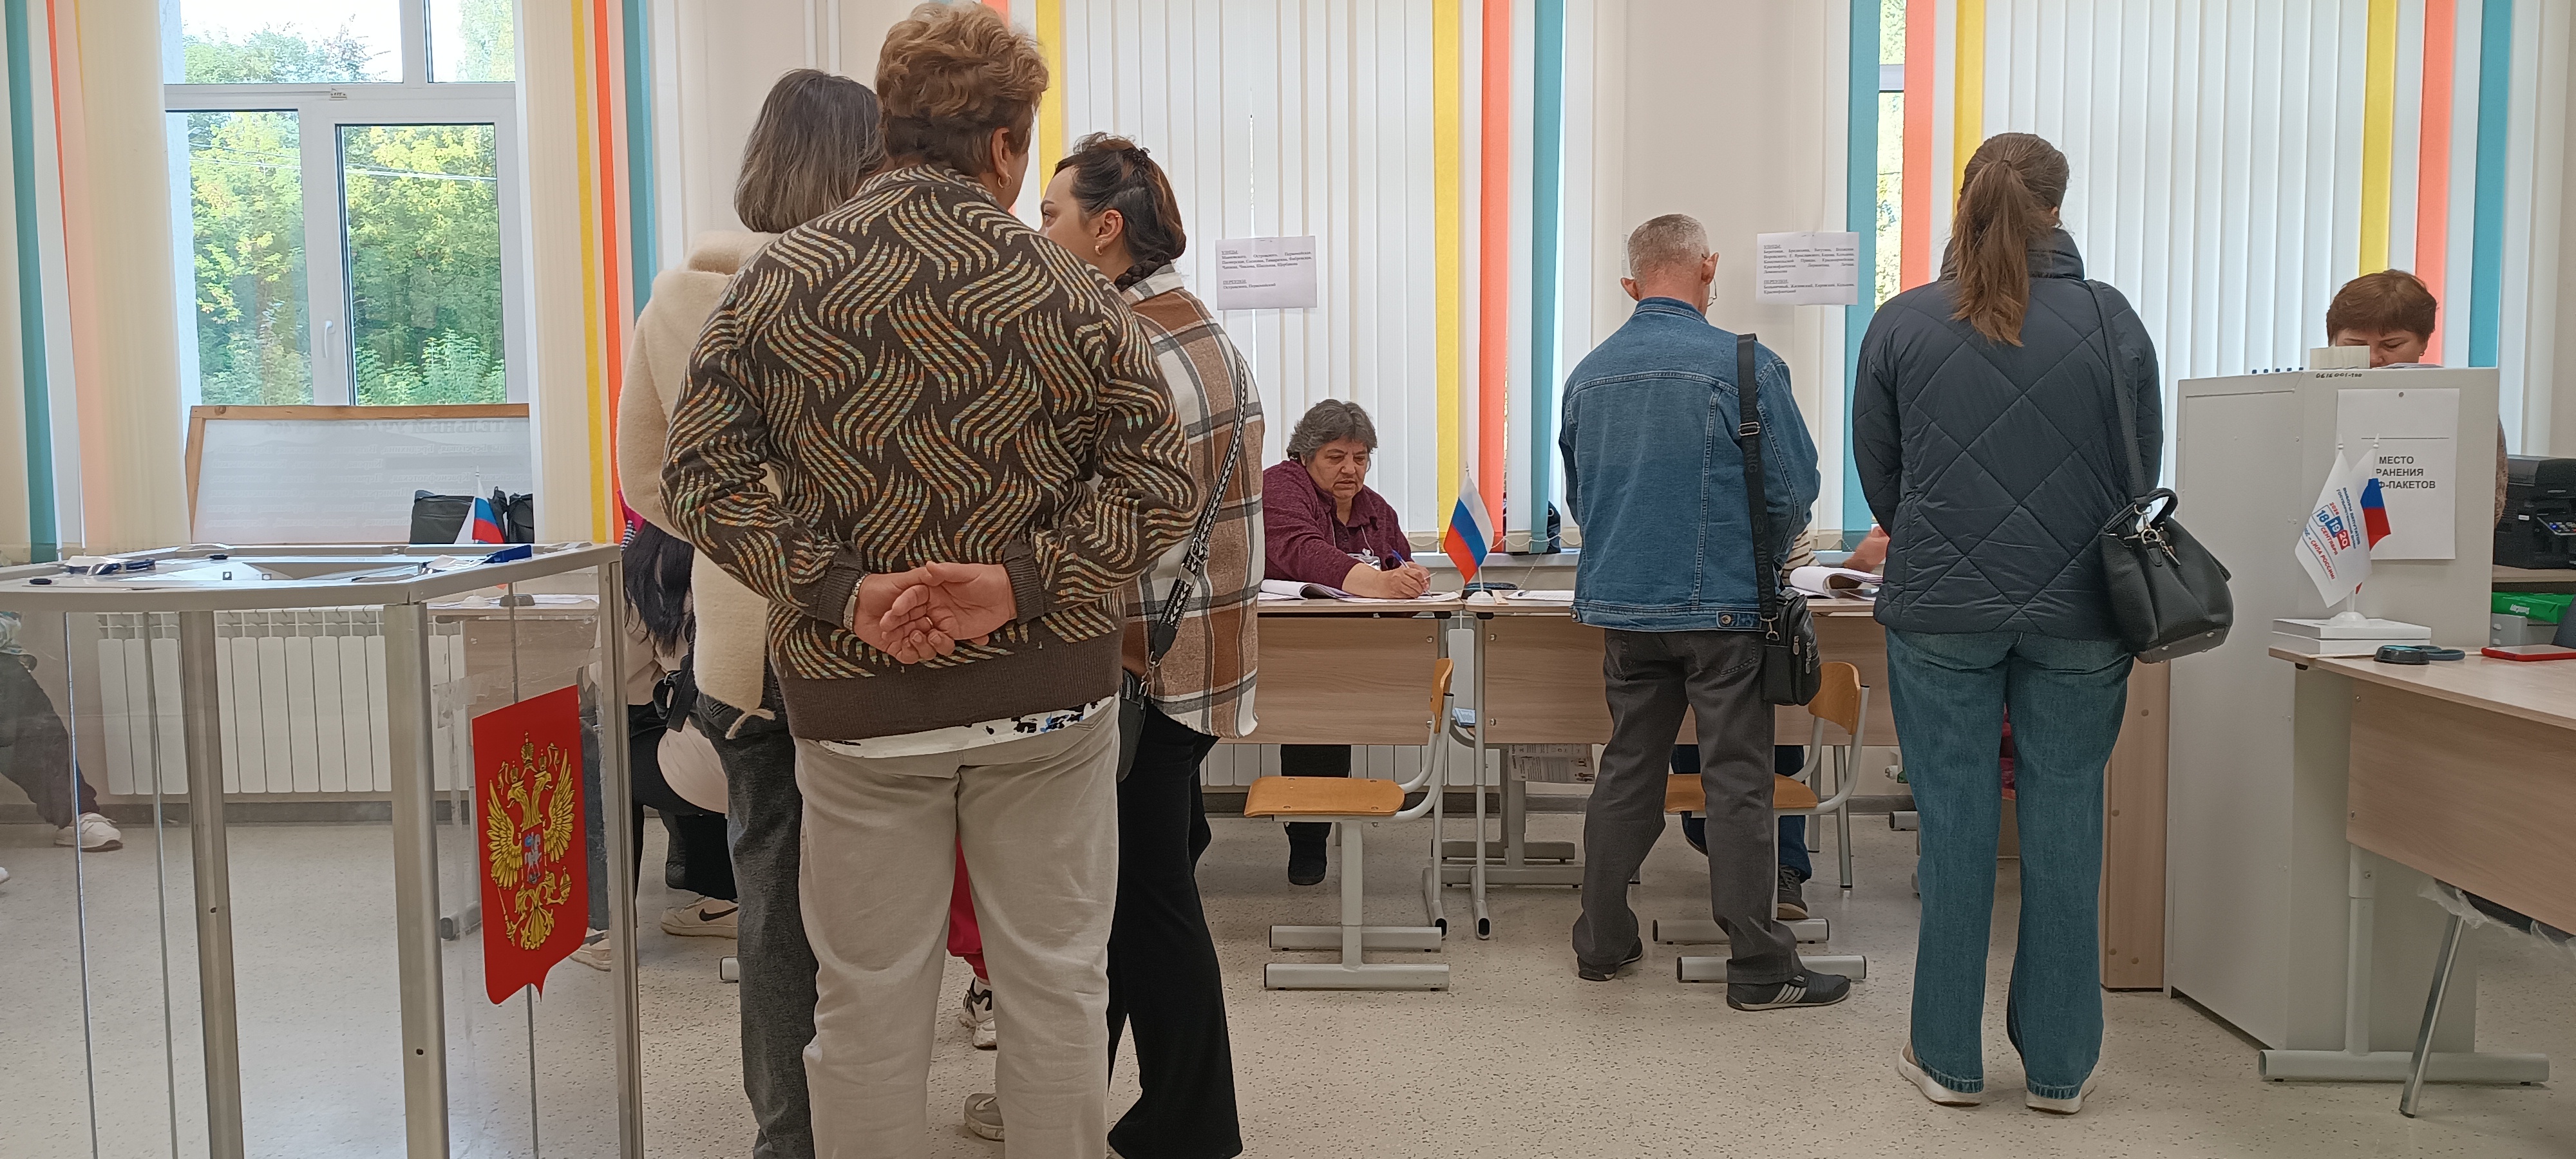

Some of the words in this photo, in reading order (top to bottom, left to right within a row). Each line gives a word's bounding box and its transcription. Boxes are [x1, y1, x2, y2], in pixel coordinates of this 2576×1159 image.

[2379, 456, 2414, 464] МЕСТО
[2376, 468, 2424, 476] РАНЕНИЯ
[2379, 480, 2436, 489] Ф-ПАКЕТОВ
[2316, 510, 2330, 523] 18
[2329, 519, 2341, 532] 19
[2339, 531, 2348, 545] 20
[2321, 527, 2338, 555] СЕНТЯБРЯ
[2311, 540, 2322, 555] СИЛА
[2320, 554, 2335, 580] РОССИИ!
